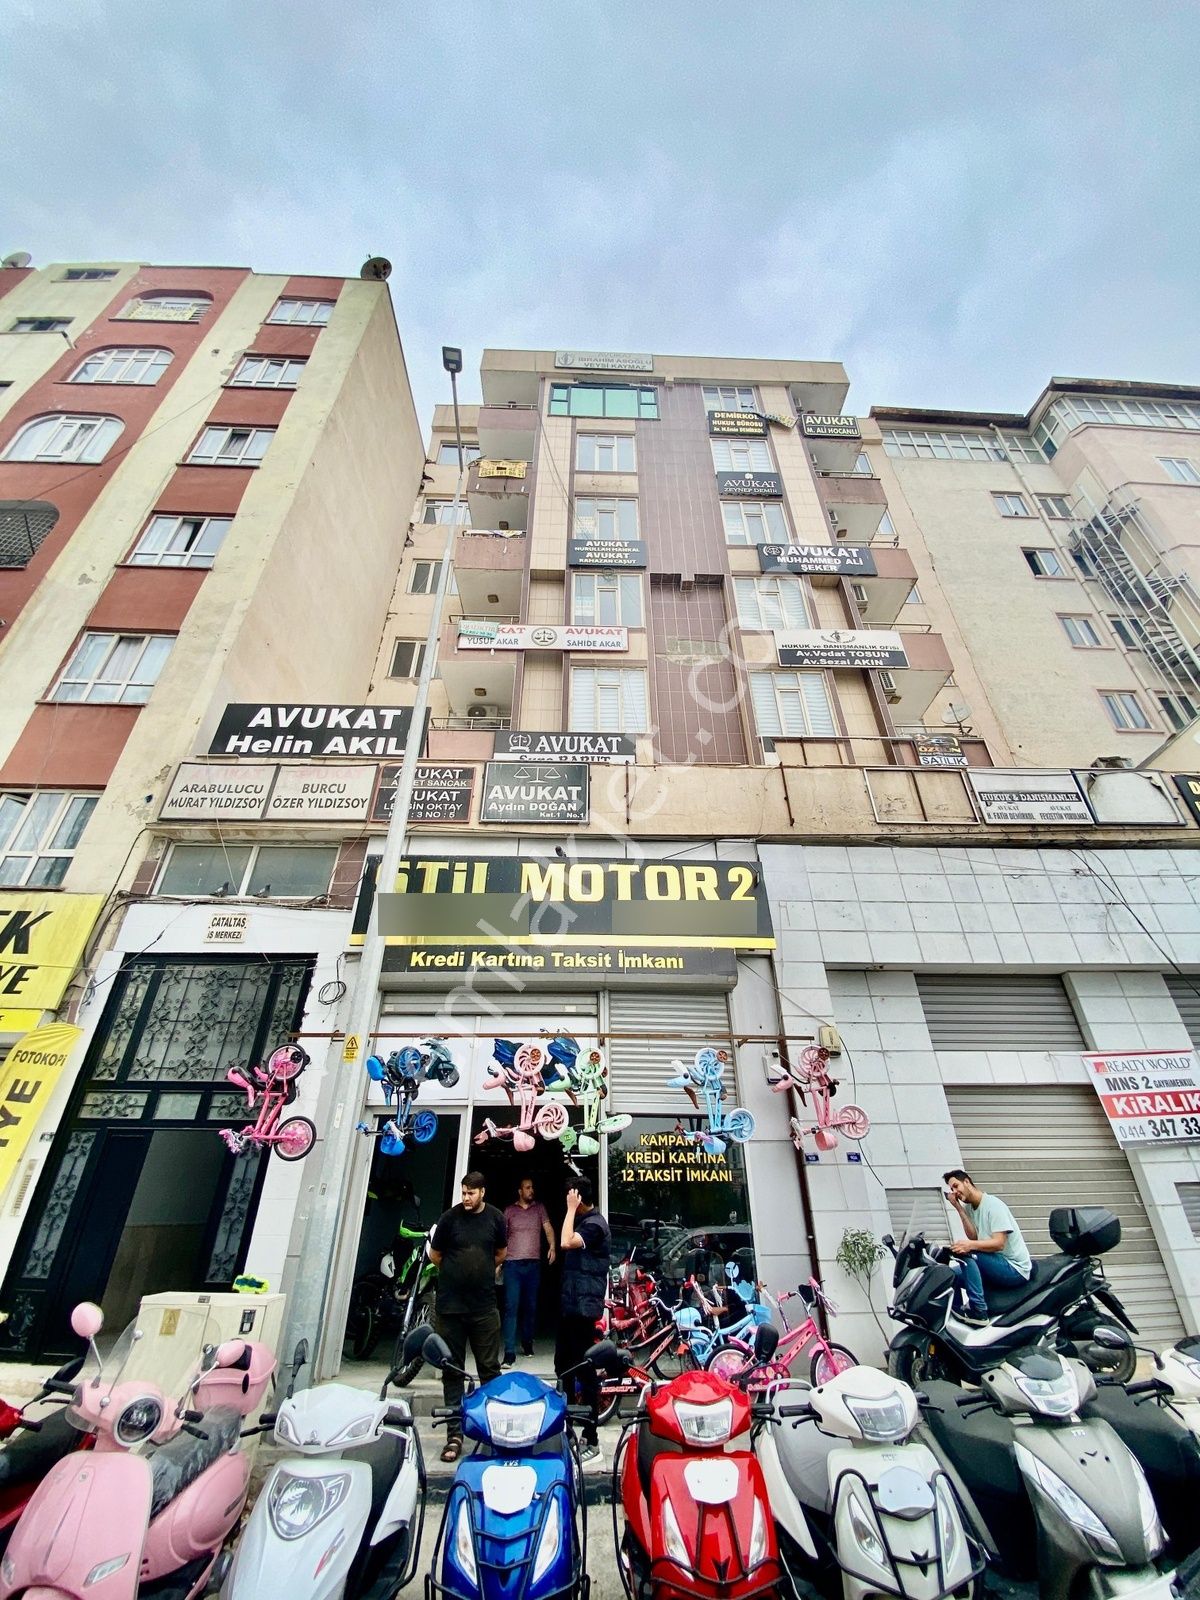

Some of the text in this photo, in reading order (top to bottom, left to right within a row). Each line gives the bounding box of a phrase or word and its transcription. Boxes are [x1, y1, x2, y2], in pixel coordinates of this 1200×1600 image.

[806, 416, 854, 426] AVUKAT
[724, 479, 777, 488] AVUKAT
[787, 546, 859, 557] AVUKAT
[776, 556, 863, 565] MUHAMMED ALİ
[565, 628, 623, 636] AVUKAT
[468, 637, 495, 645] YUSUF
[248, 707, 401, 730] AVUKAT
[225, 735, 406, 755] Helin AKIL
[535, 736, 622, 753] AVUKAT
[394, 768, 464, 779] AUKAT
[180, 783, 264, 794] ARABULUCU
[301, 783, 347, 794] BURCU
[488, 786, 582, 801] AVUKAT
[390, 790, 460, 801] AUKAT
[981, 793, 1011, 801] HUKUK
[168, 797, 265, 809] MURAT YILDIZSOY
[272, 795, 368, 809] ÖZER YILDIZSOY
[384, 802, 424, 810] LEİN
[488, 800, 577, 811] Aydın DOĞAN
[521, 863, 719, 902] MOTOR
[727, 867, 756, 901] 2
[410, 949, 684, 969] Kredi Kartına Taksit İmkanı
[1105, 1057, 1189, 1072] REALTY WORLD
[1105, 1076, 1139, 1091] MNS
[1141, 1076, 1153, 1089] 2
[1148, 1119, 1177, 1137] 347
[626, 1150, 726, 1164] KREDİ KARTINA
[622, 1167, 733, 1182] 12 TAKSİT İMKANI
